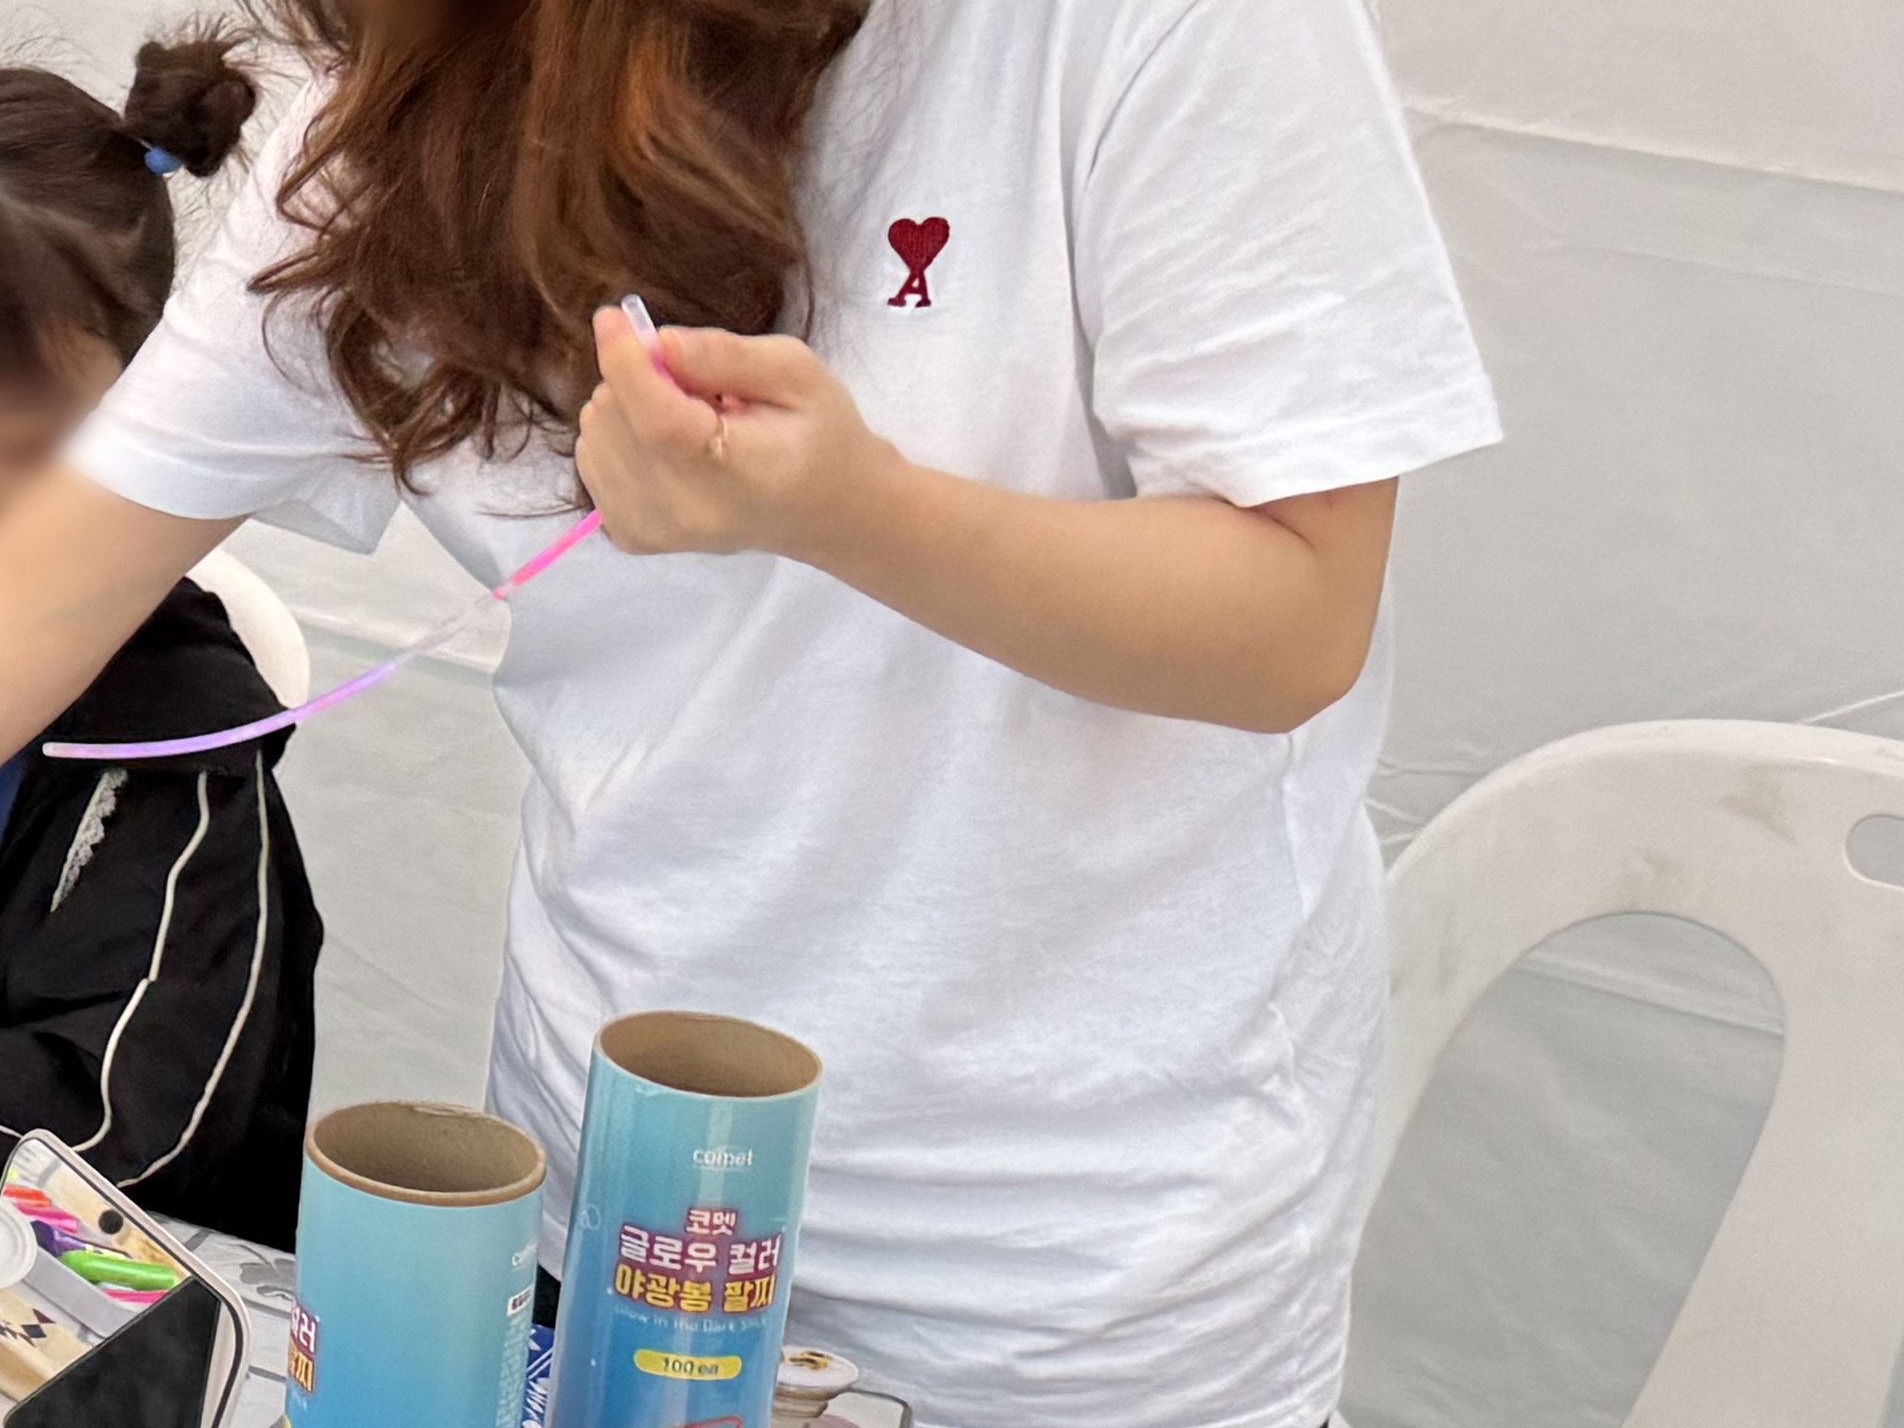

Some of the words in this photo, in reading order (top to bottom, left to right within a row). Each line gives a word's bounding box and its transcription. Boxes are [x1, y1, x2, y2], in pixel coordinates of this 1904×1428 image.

[686, 1208, 736, 1236] 코멧
[620, 1224, 717, 1273] 글로우
[728, 1234, 782, 1275] 컬러
[614, 1263, 712, 1314] 야광봉
[723, 1275, 776, 1314] 팔찌
[663, 1357, 695, 1375] 100
